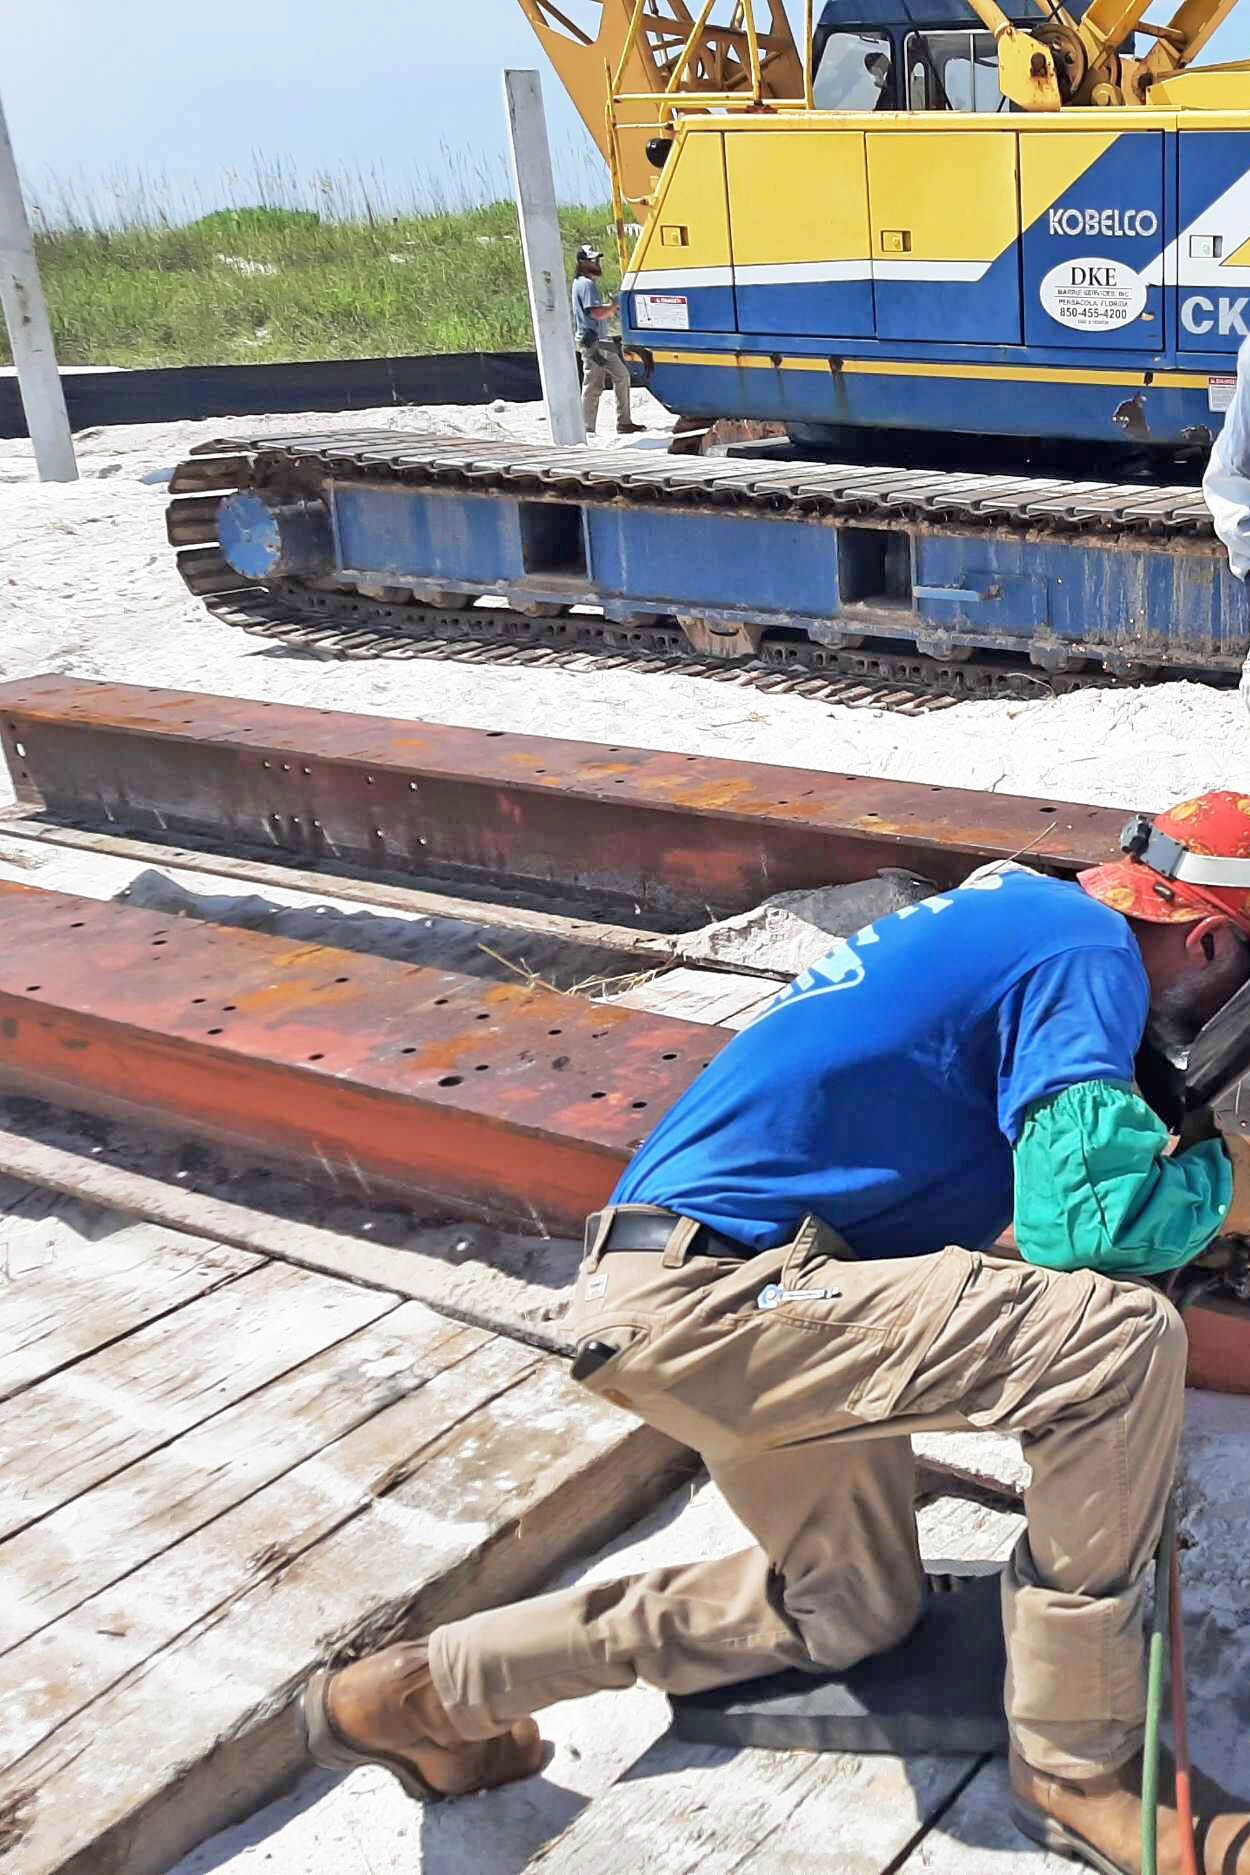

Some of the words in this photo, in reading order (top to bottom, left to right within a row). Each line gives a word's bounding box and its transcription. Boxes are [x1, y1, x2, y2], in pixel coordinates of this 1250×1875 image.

[1048, 208, 1158, 237] KOBELCO
[1071, 266, 1117, 287] DKE
[1060, 307, 1127, 319] 850-455-4200
